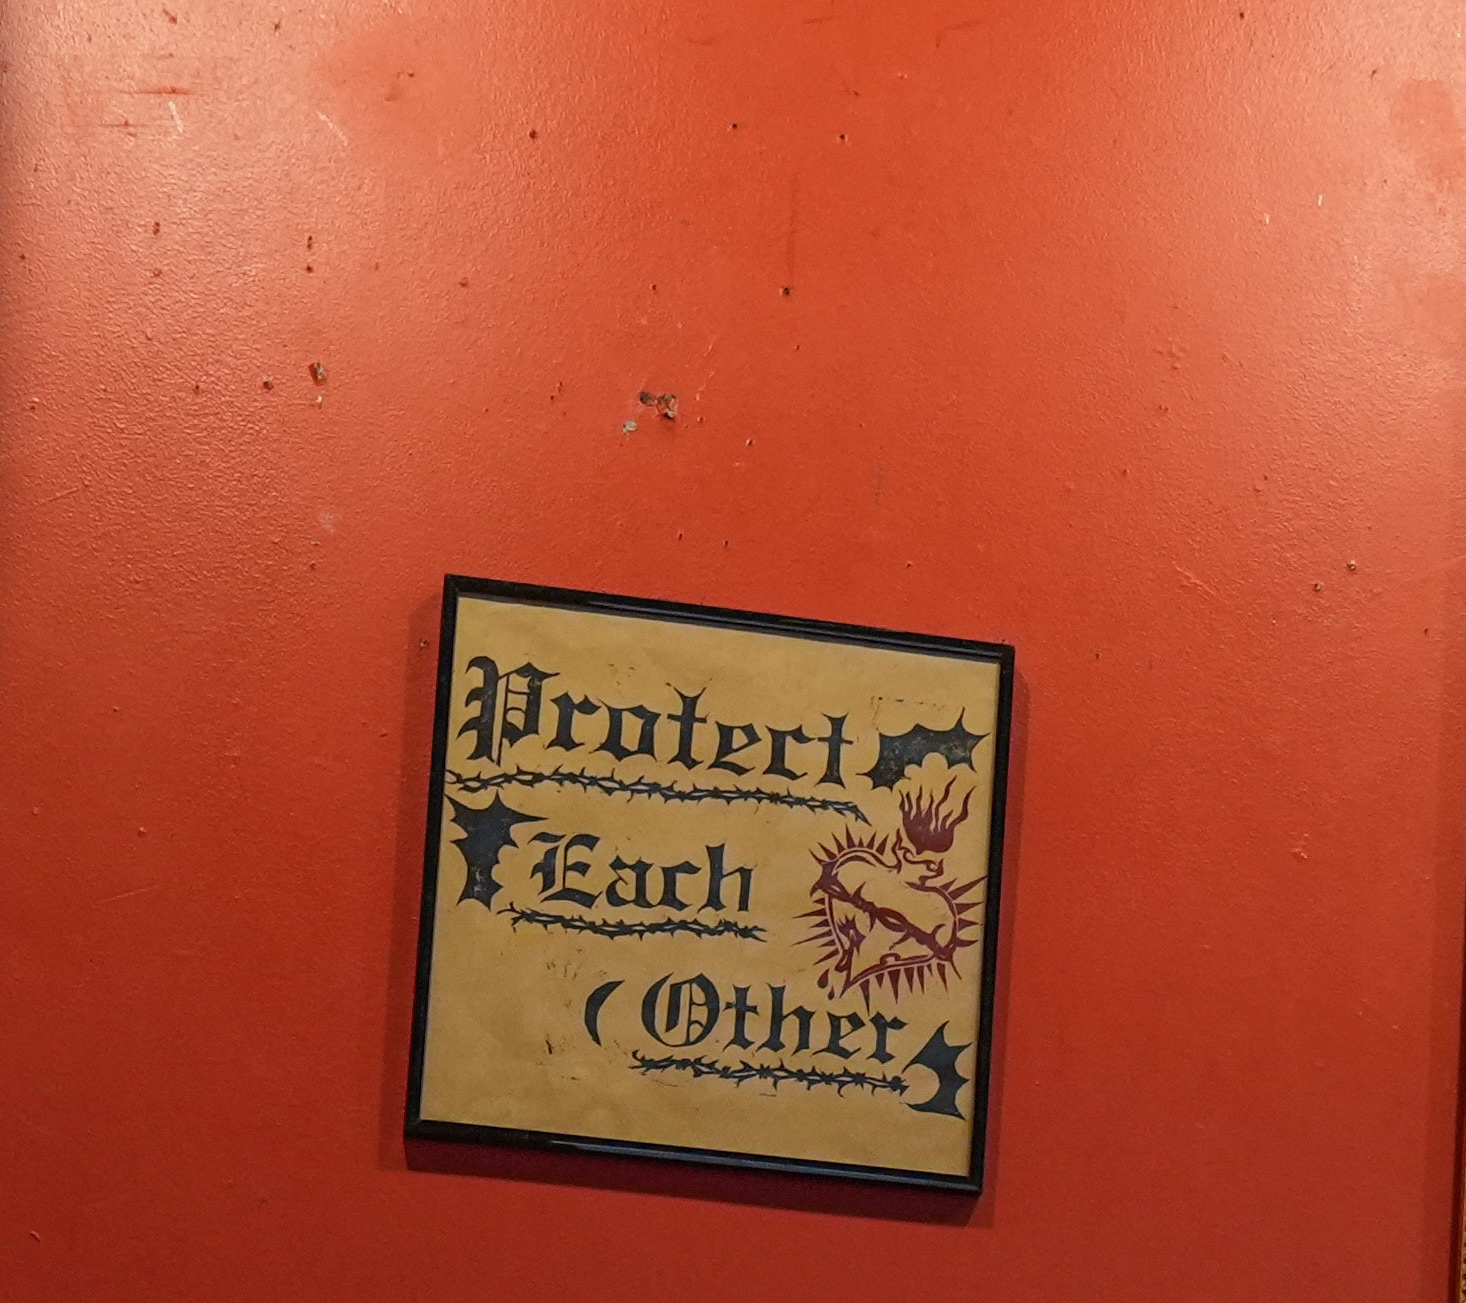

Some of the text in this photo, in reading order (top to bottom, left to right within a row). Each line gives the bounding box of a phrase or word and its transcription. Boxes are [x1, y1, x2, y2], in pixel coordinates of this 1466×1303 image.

[456, 655, 855, 788] Protect
[530, 832, 757, 914] Each
[640, 971, 908, 1063] Other
